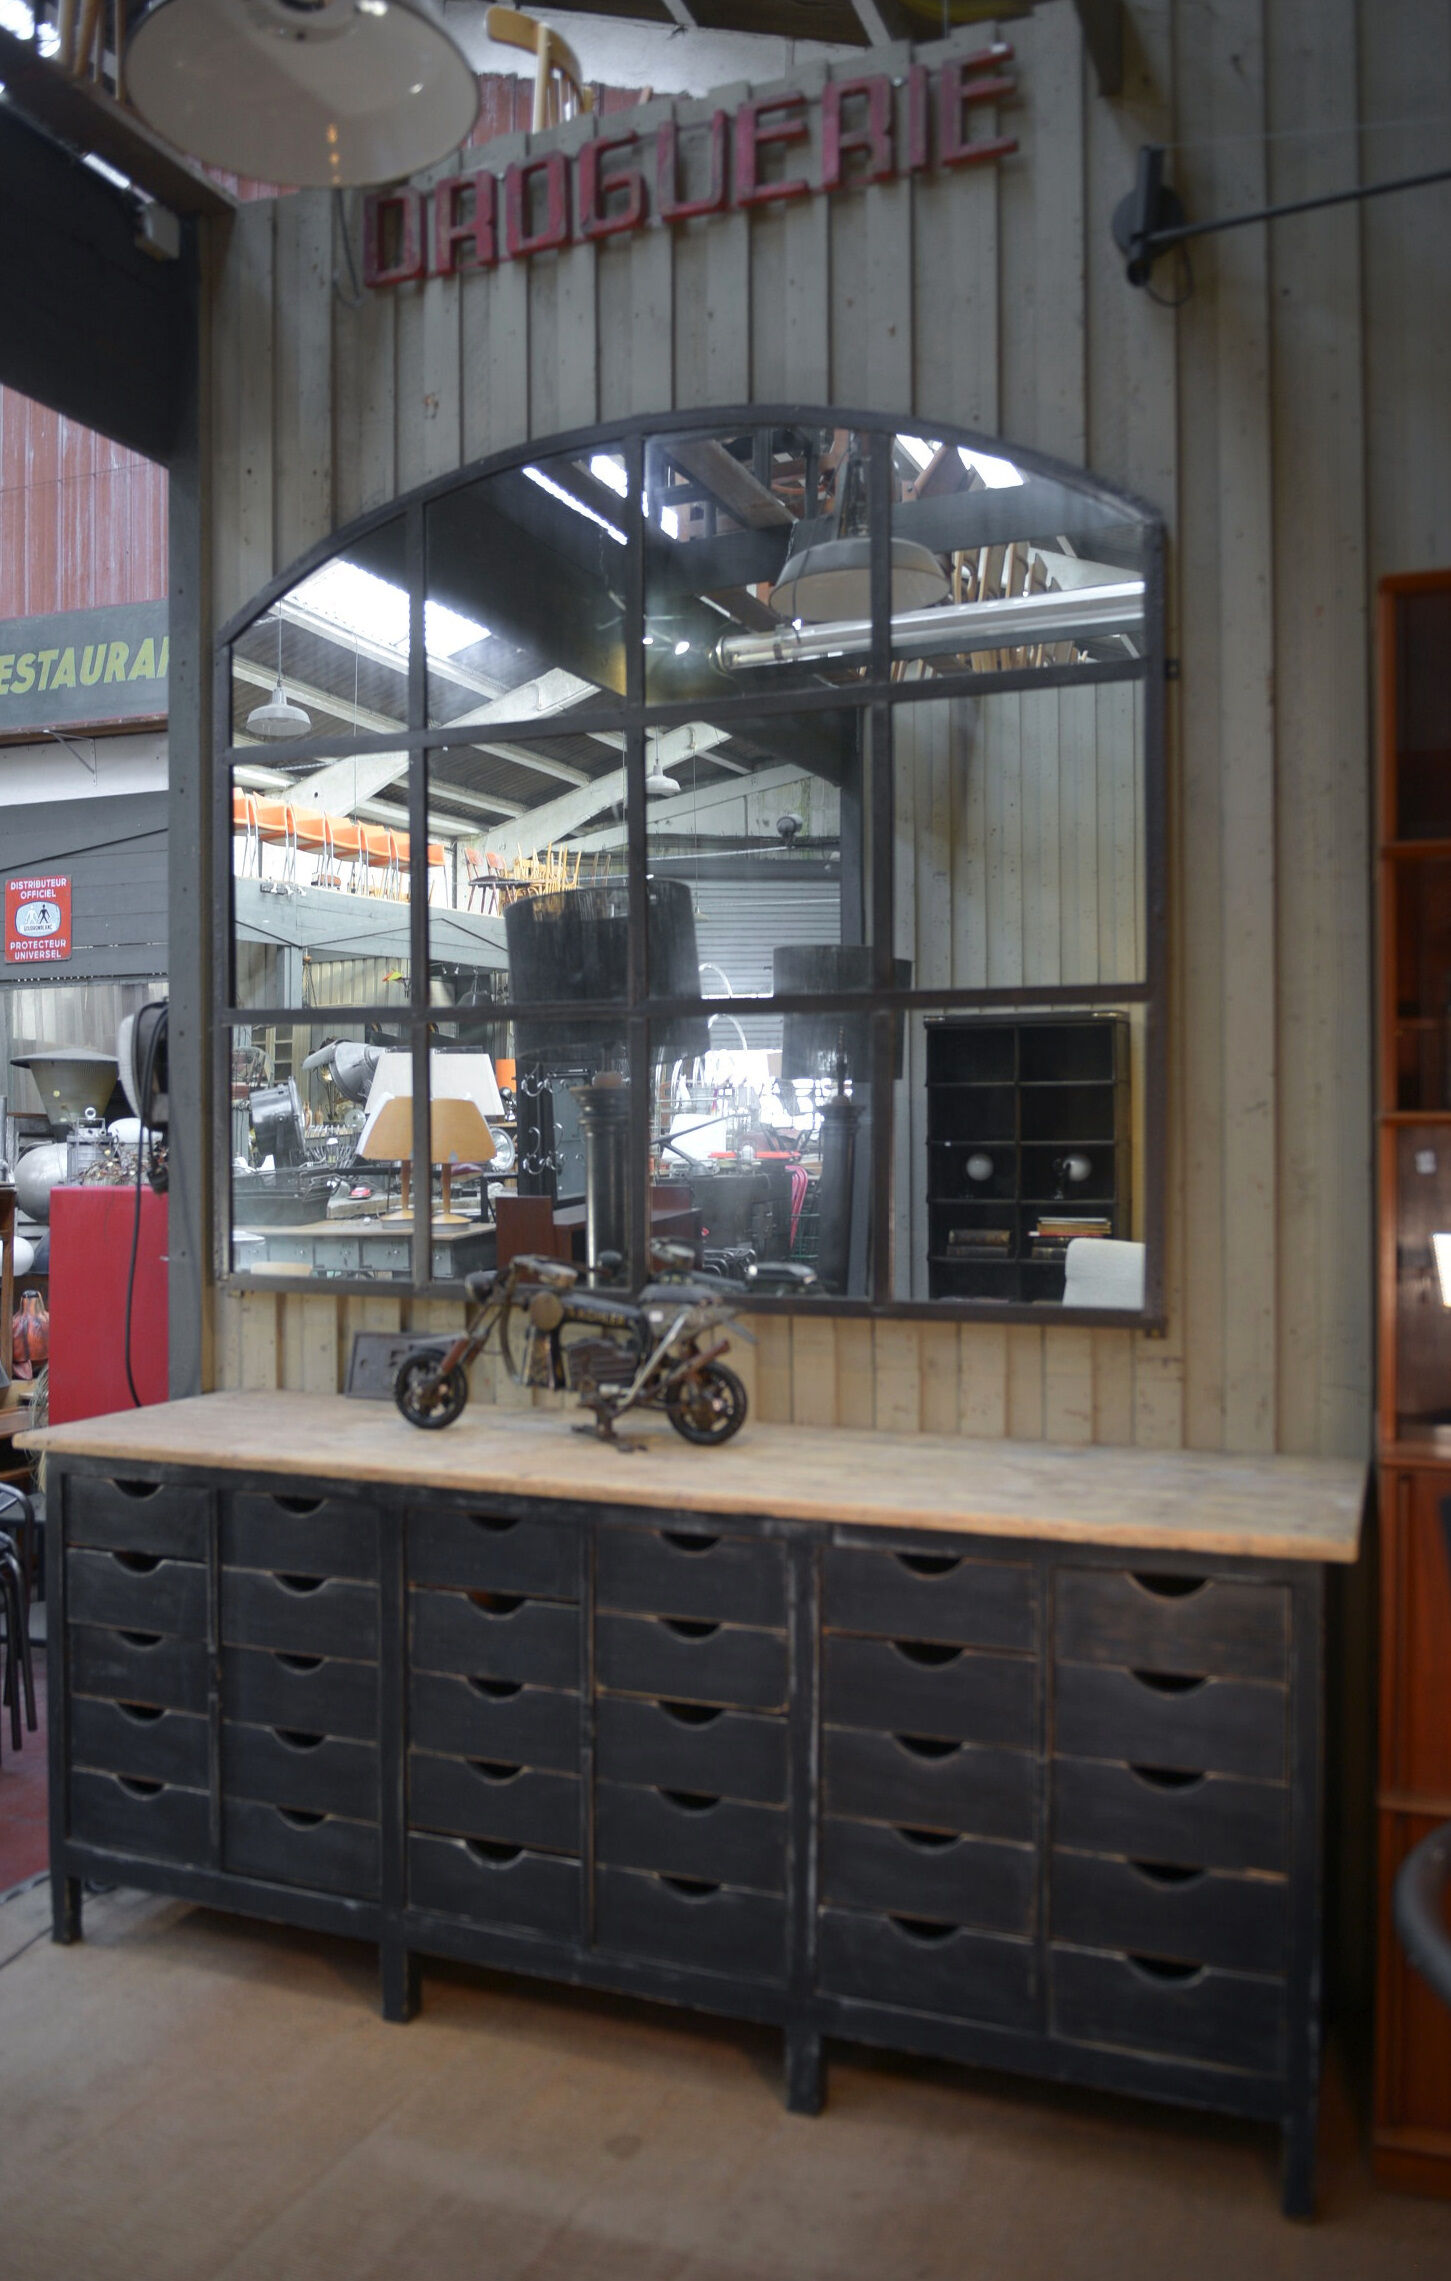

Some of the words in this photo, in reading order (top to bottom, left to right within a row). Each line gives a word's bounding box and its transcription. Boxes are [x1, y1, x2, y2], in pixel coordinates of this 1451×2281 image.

[363, 43, 1019, 287] DROGUERIE
[10, 878, 67, 890] DISTRIBUTEUR
[20, 889, 56, 900] OFFICIEL
[10, 939, 67, 950] PROTECTEUR
[14, 949, 61, 960] UNIVERSEL
